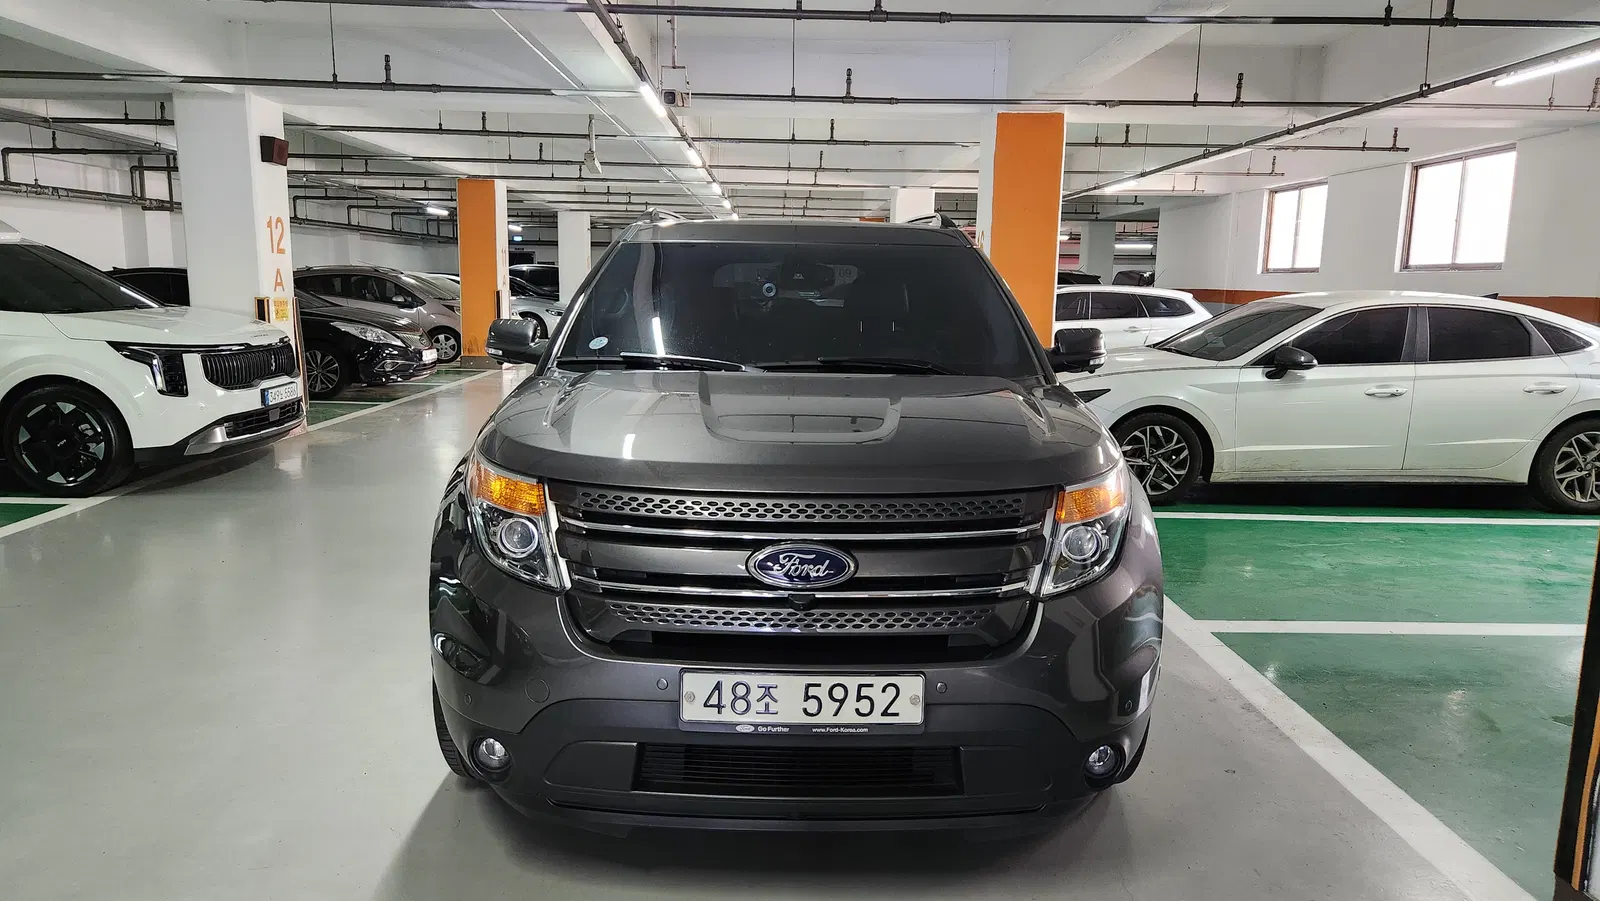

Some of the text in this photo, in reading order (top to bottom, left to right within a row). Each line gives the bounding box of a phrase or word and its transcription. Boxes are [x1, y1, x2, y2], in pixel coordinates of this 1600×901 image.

[267, 216, 286, 254] 12
[274, 268, 285, 292] A
[772, 552, 835, 578] Ford
[703, 680, 901, 718] 48조 5952
